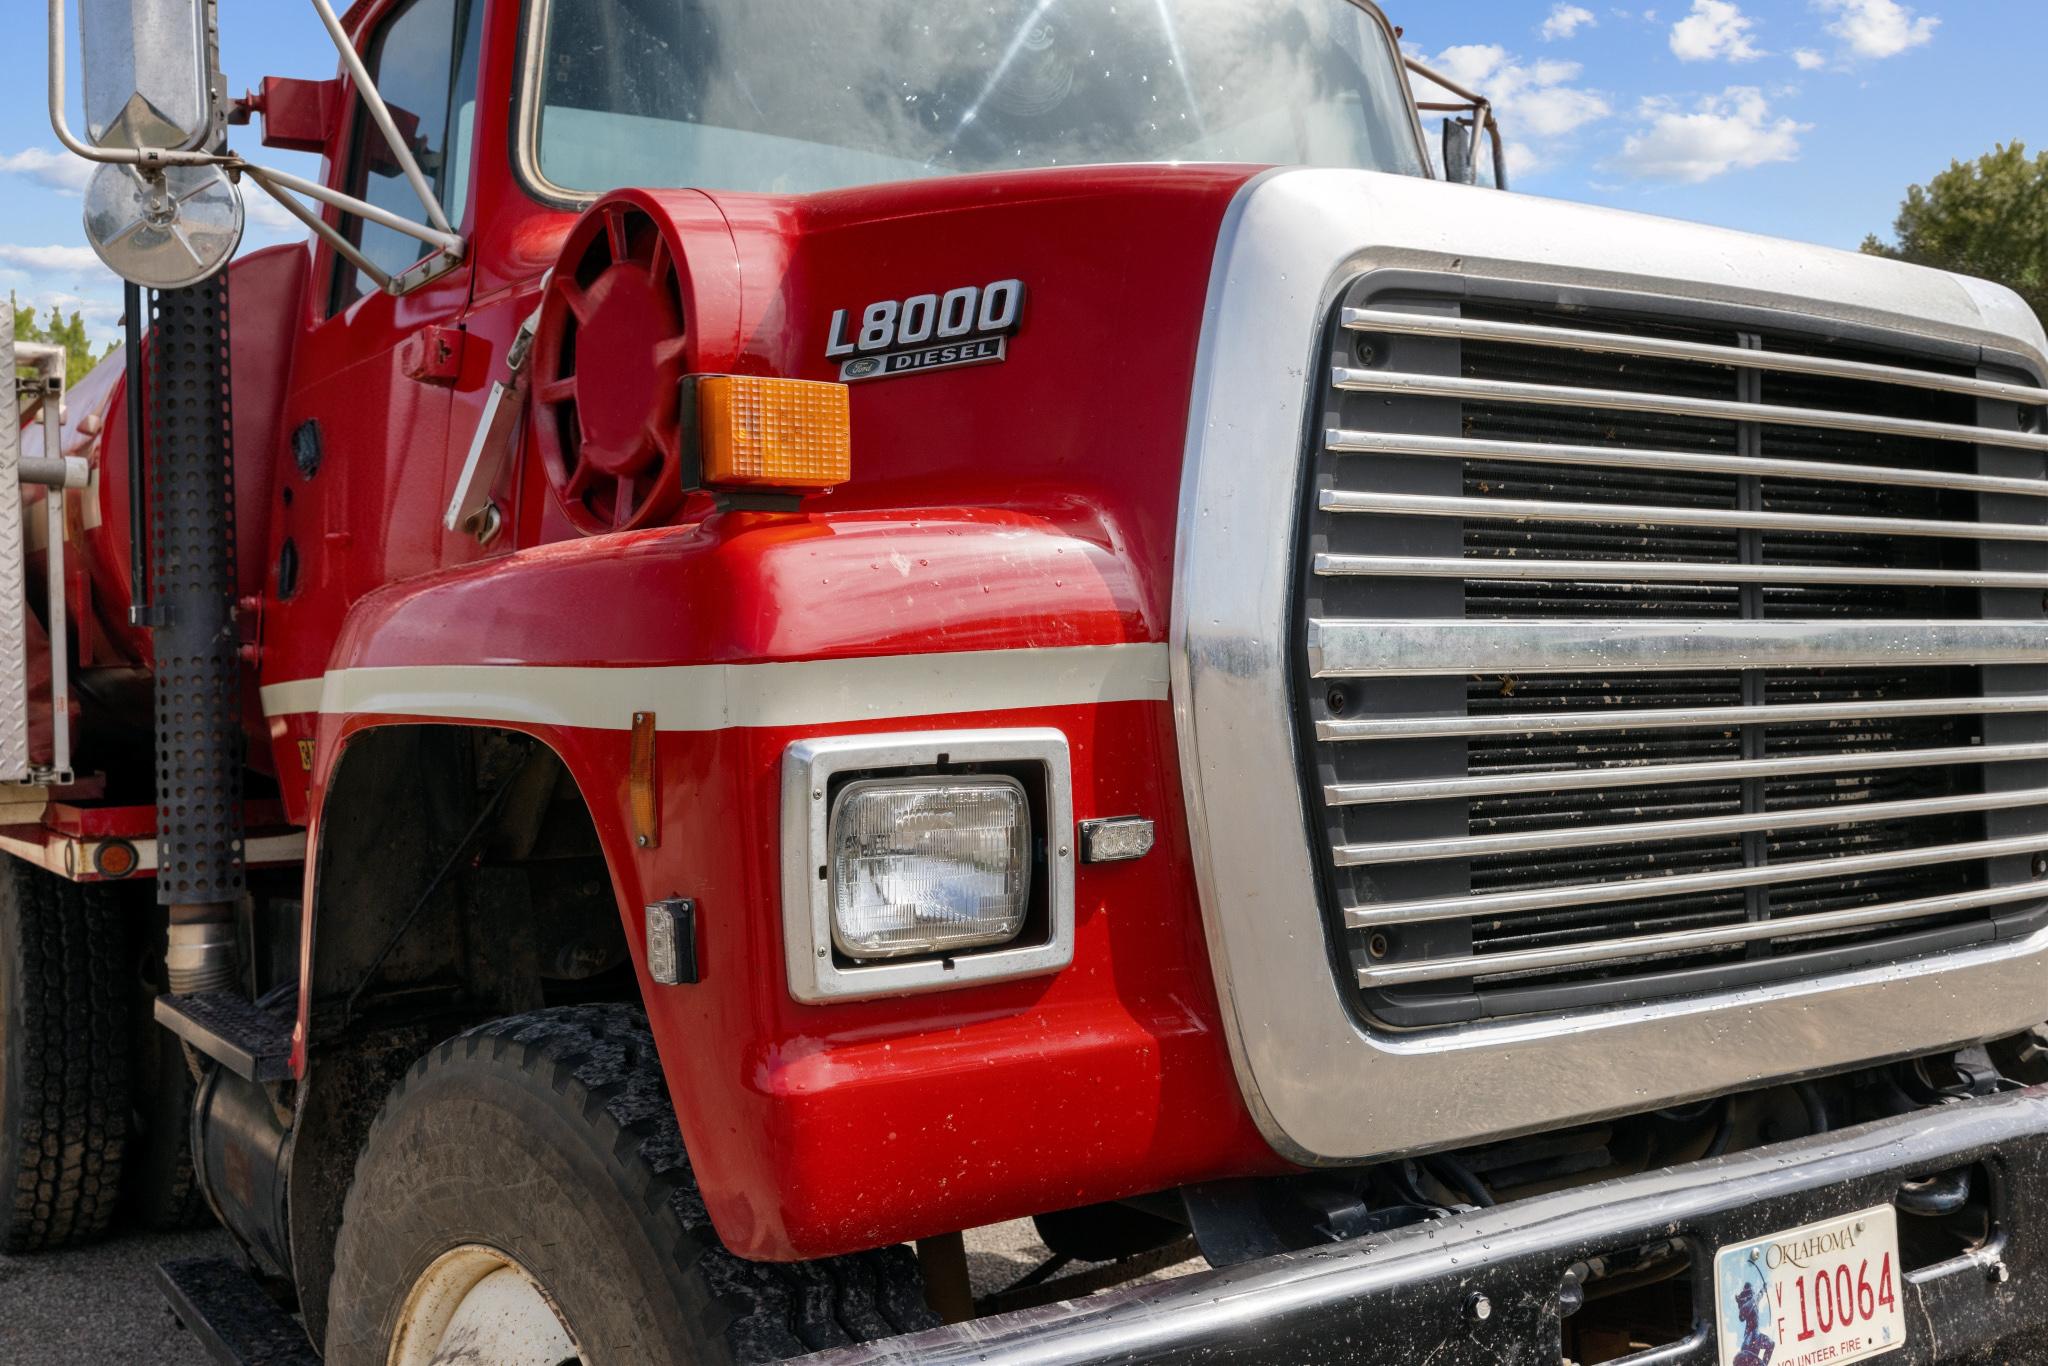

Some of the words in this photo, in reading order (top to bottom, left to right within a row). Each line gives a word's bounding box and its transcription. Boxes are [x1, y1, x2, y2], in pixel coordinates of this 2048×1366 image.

[825, 279, 1023, 358] L8000
[851, 360, 874, 375] Ford
[895, 341, 992, 369] DIESEL
[1766, 1226, 1856, 1270] OKLAHOMA
[1795, 1251, 1895, 1342] 10064
[1840, 1337, 1861, 1355] FIRE
